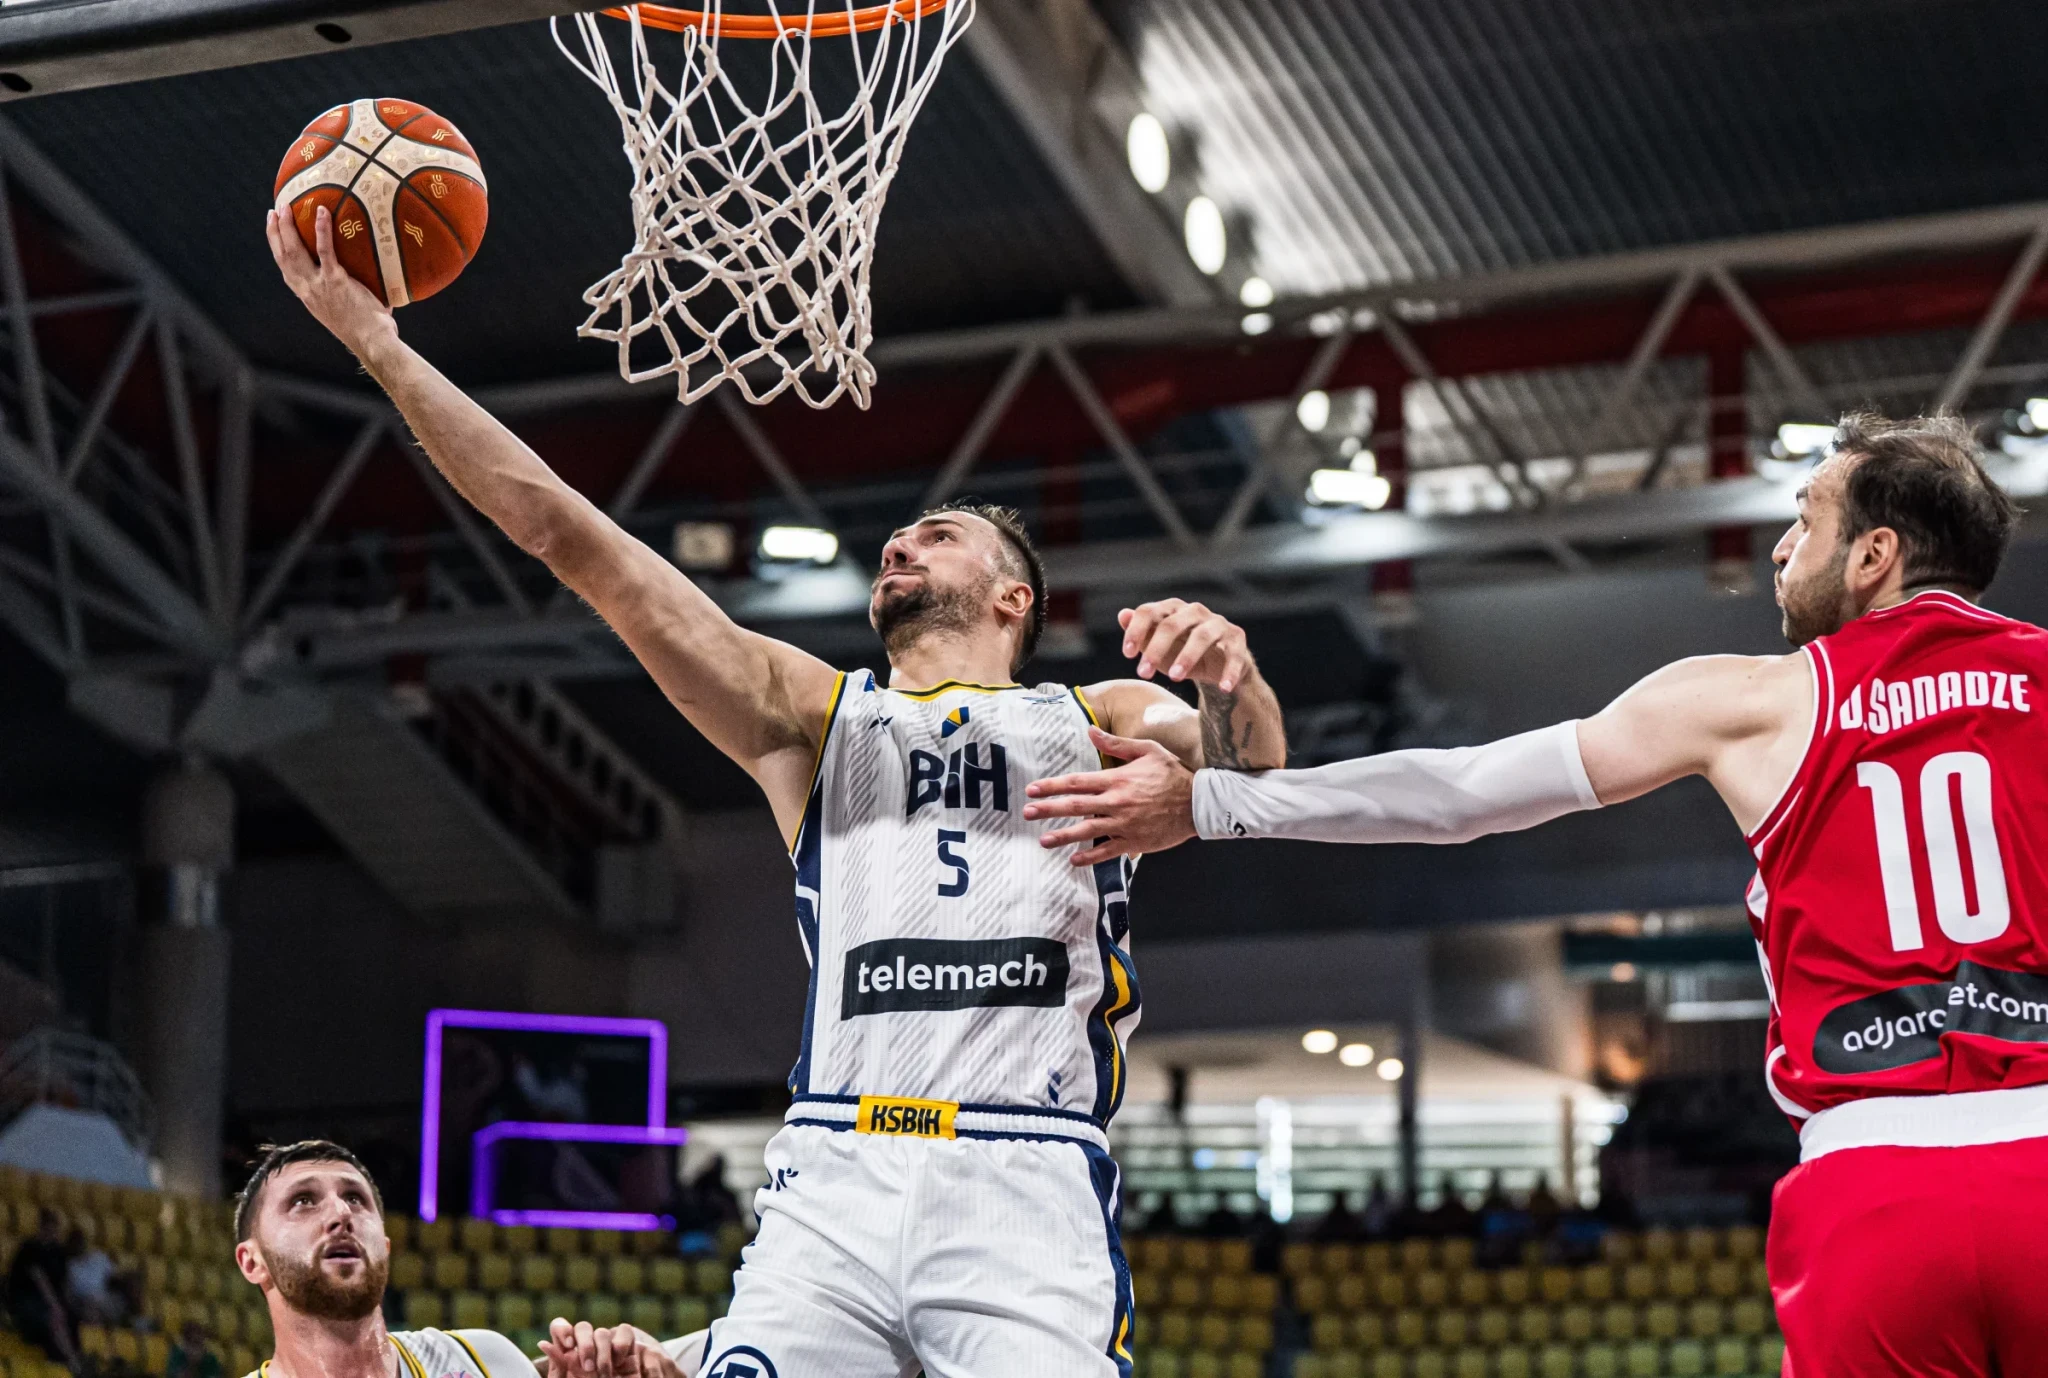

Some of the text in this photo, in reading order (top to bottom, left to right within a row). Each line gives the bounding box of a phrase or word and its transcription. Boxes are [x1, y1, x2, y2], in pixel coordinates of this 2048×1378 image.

[937, 829, 970, 898] 5
[1856, 751, 2011, 952] 10
[858, 954, 1047, 993] telemach
[870, 1105, 941, 1135] KSBIH
